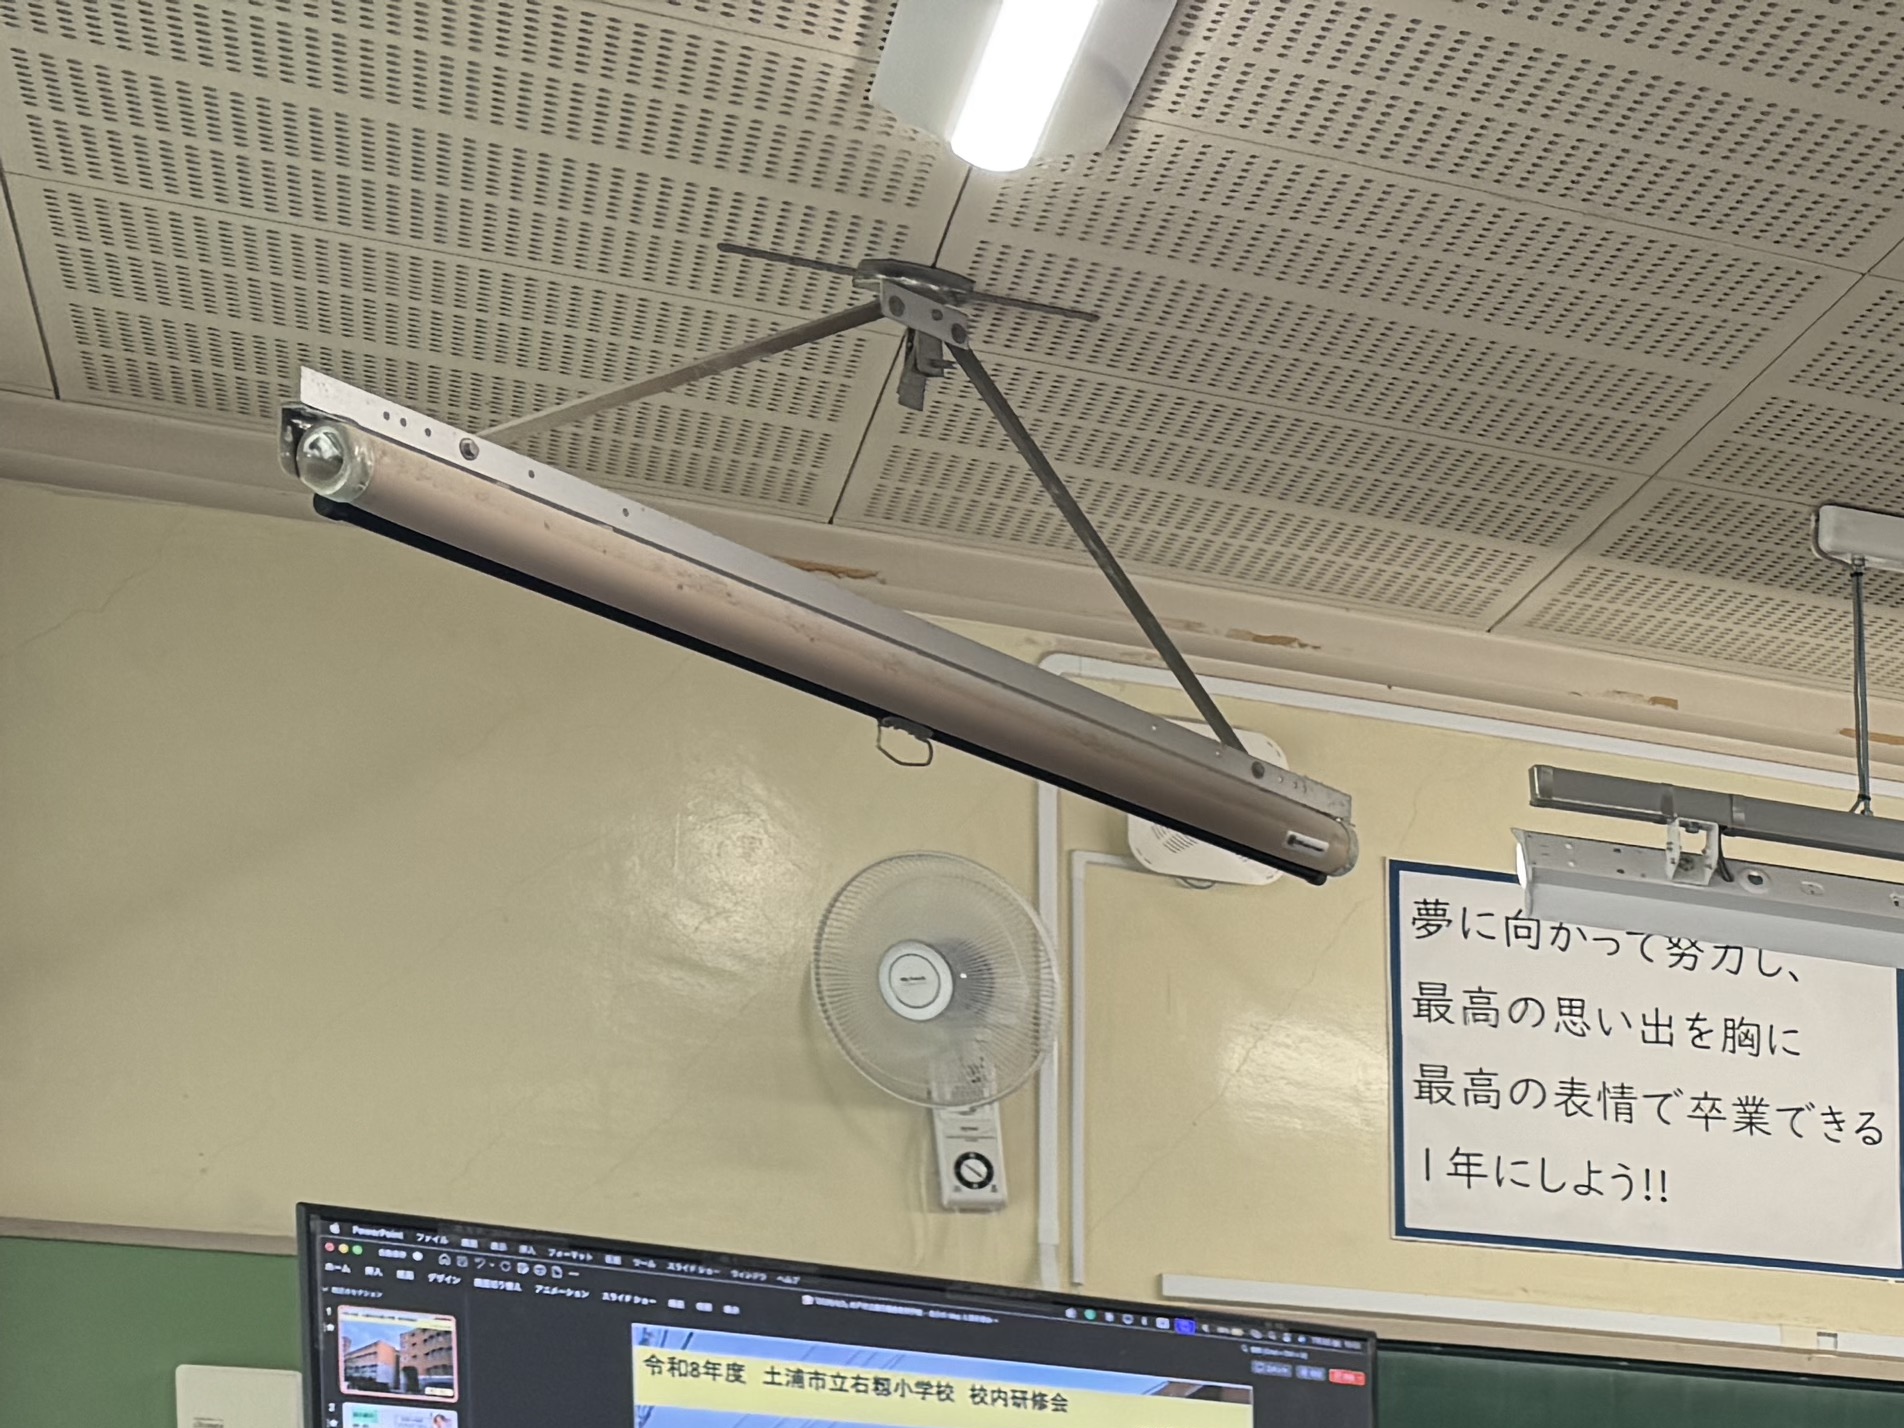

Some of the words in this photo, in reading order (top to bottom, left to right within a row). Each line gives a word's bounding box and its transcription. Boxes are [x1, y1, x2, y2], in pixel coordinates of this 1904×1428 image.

[1411, 897, 1800, 982] 夢に向かって努力し、
[1411, 980, 1801, 1058] 最高の思い出を胸に
[1412, 1062, 1884, 1147] 最高の表情で卒業できる
[643, 1352, 747, 1386] 令和8年度
[968, 1383, 1070, 1414] 校内研修会
